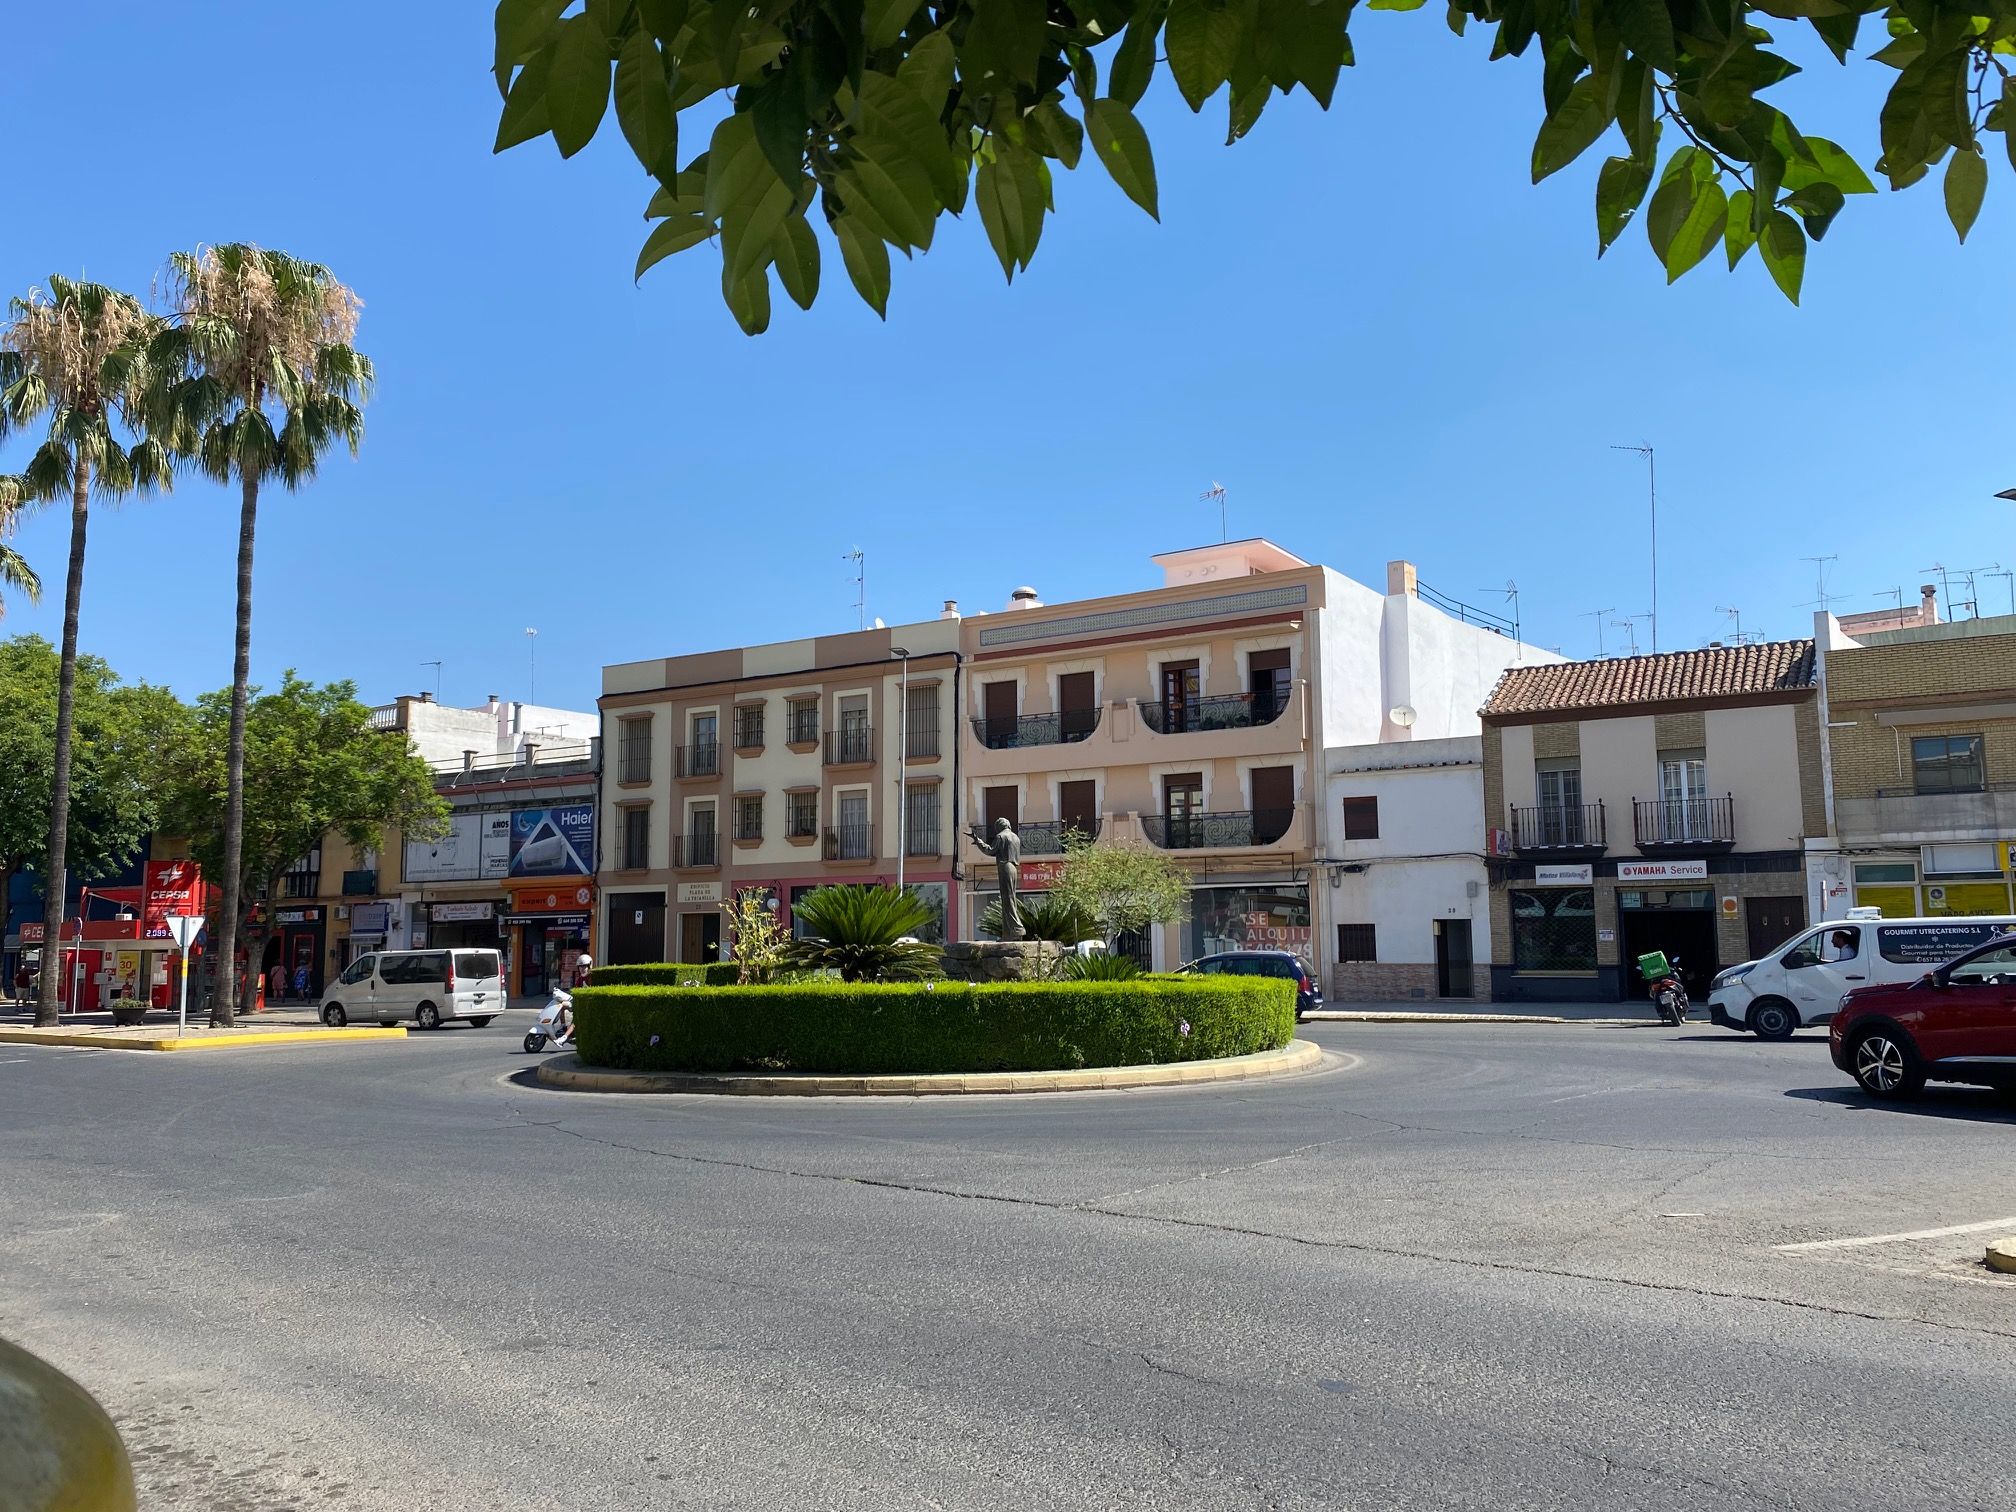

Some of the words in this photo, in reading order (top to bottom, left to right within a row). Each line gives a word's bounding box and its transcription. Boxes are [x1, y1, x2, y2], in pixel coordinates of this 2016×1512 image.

[561, 810, 593, 826] Haier
[1632, 866, 1667, 876] YAMAHA
[1670, 865, 1704, 875] Service
[151, 890, 190, 900] CEPSA
[1248, 913, 1267, 926] SE
[1246, 928, 1312, 941] ALQUIL
[1884, 928, 1917, 936] GOURMET
[1919, 926, 1970, 935] UTRECATERING
[119, 960, 133, 970] 30
